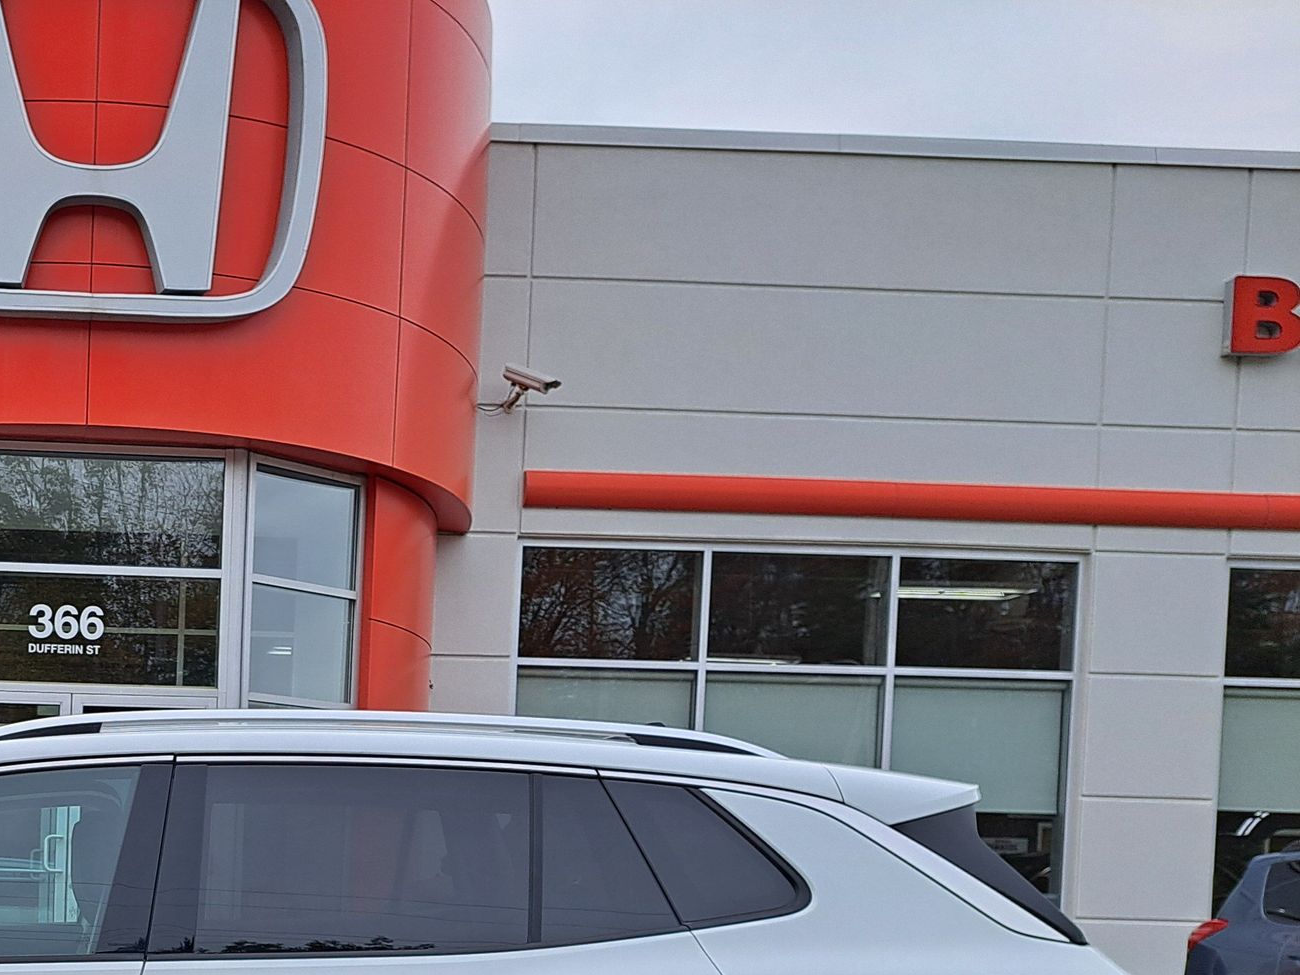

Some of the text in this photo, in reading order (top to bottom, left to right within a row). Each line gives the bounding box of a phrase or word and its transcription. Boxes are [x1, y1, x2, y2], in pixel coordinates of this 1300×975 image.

[27, 603, 105, 640] 366
[27, 643, 101, 655] DUFFERIN ST
